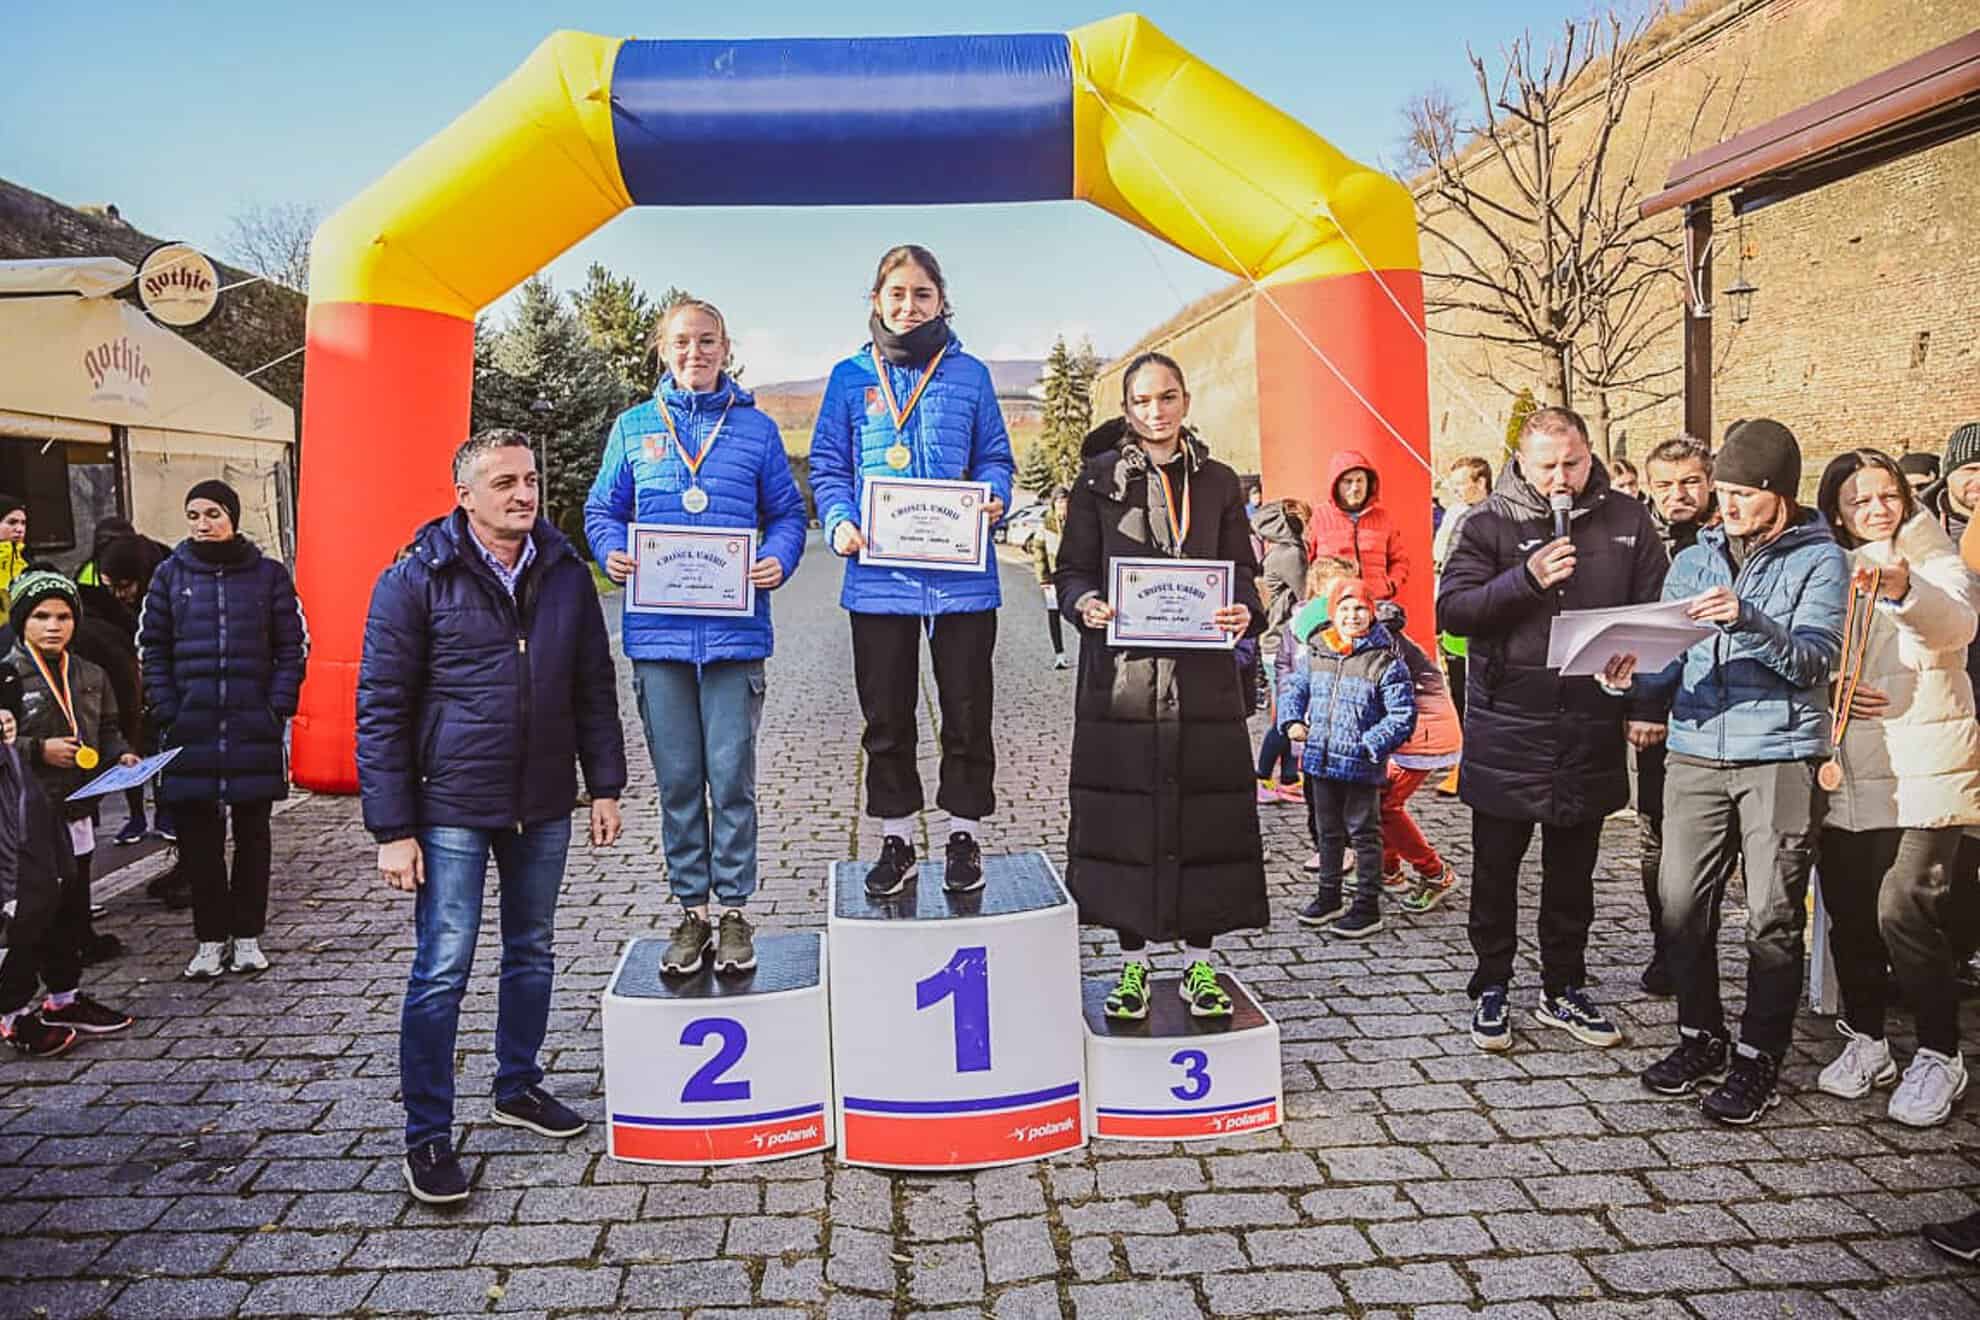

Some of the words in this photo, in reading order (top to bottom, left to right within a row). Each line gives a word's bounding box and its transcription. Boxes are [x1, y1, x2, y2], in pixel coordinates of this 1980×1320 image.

[144, 266, 212, 298] gothic
[84, 335, 151, 389] gothic
[916, 946, 991, 1073] 1
[680, 1017, 751, 1103] 2
[1170, 1049, 1211, 1101] 3
[767, 1125, 818, 1148] polanik
[1028, 1117, 1075, 1141] polanik
[1225, 1110, 1271, 1131] polanik
